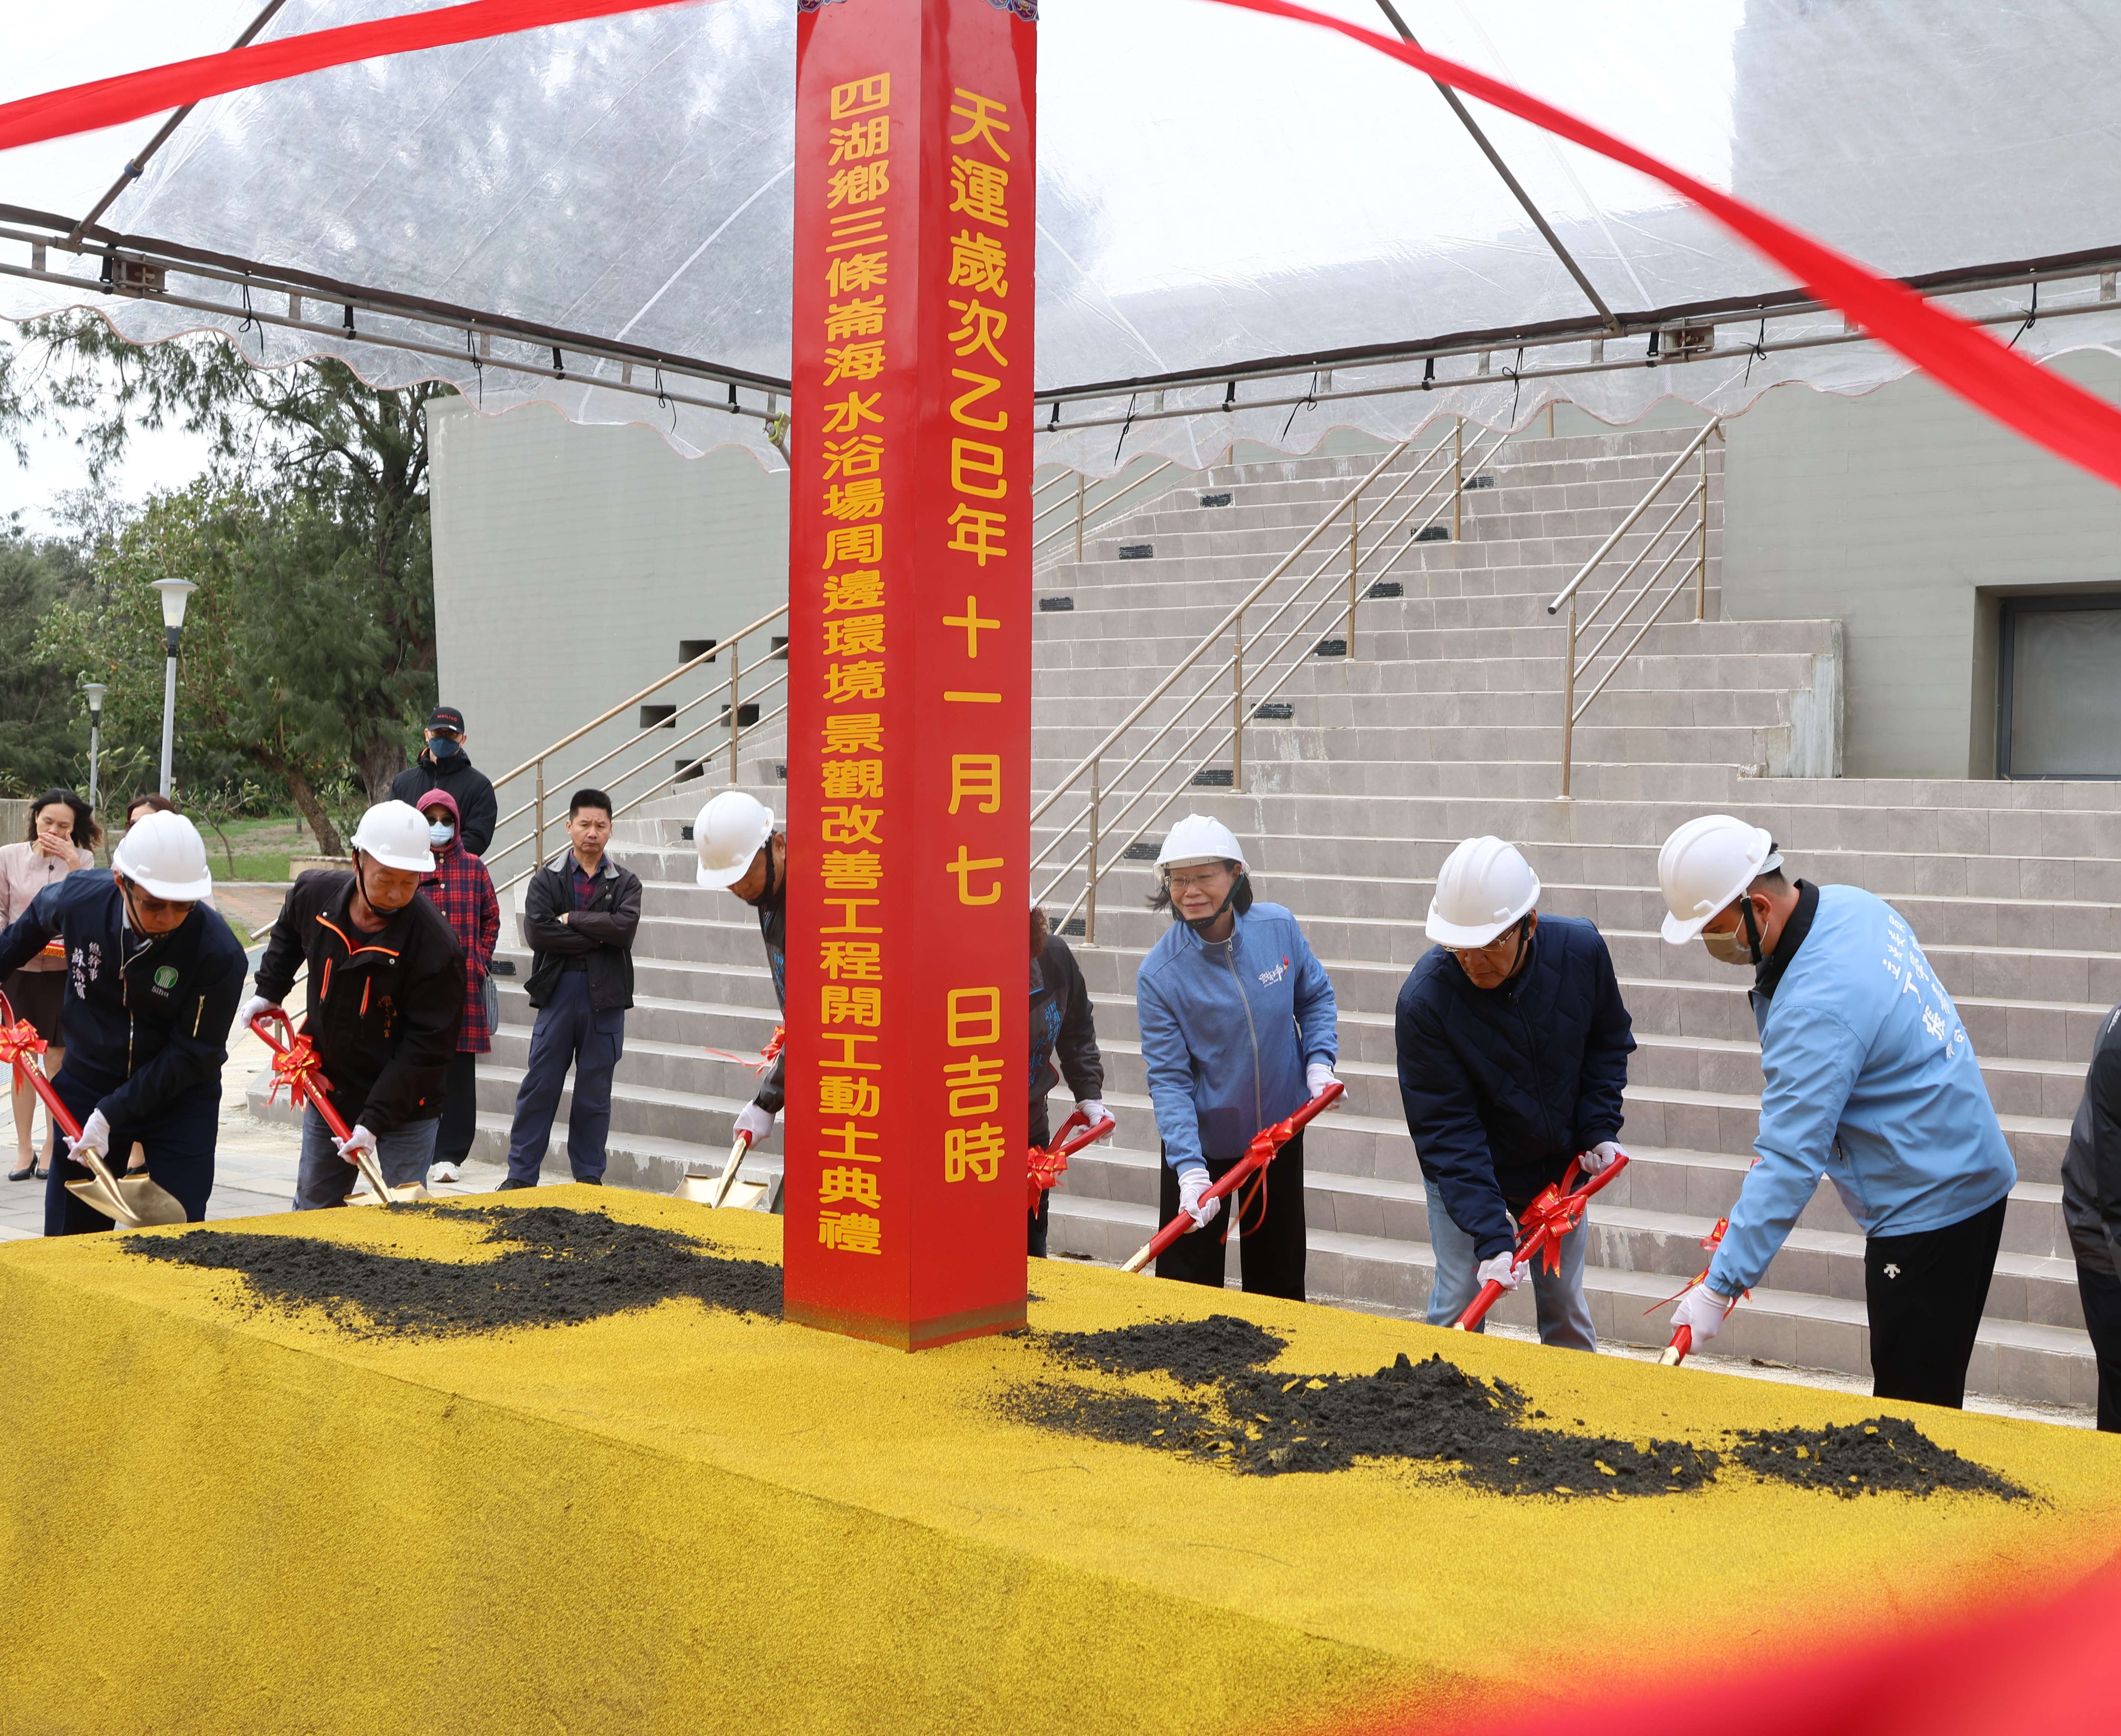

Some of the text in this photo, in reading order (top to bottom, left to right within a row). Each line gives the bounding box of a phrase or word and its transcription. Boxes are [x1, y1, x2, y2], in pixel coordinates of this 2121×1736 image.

[818, 72, 890, 1256] 四湖鄉三條崙海水浴場周邊環境景觀改善工程開工動土典禮
